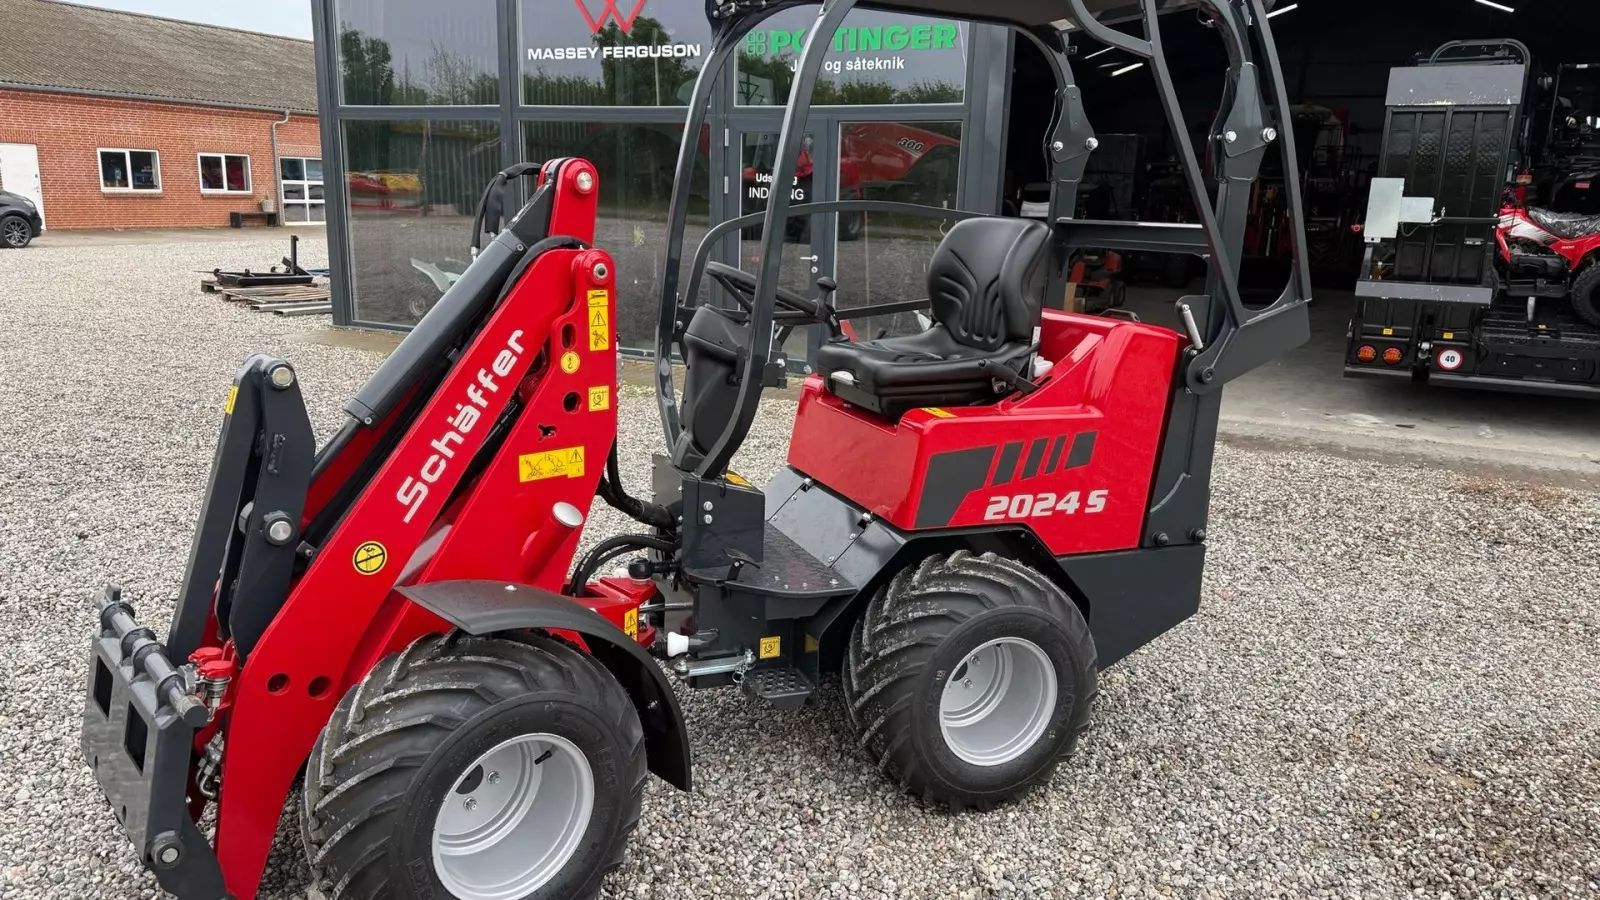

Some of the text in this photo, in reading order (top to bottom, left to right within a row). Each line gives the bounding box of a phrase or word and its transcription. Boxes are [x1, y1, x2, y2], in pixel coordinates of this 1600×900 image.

[770, 23, 958, 54] PTINGER
[527, 44, 701, 60] MASSEY FERGUSON
[824, 56, 905, 74] og såteknik
[1444, 355, 1456, 363] 40
[396, 329, 524, 523] Schäffer
[984, 489, 1109, 520] 2024 S
